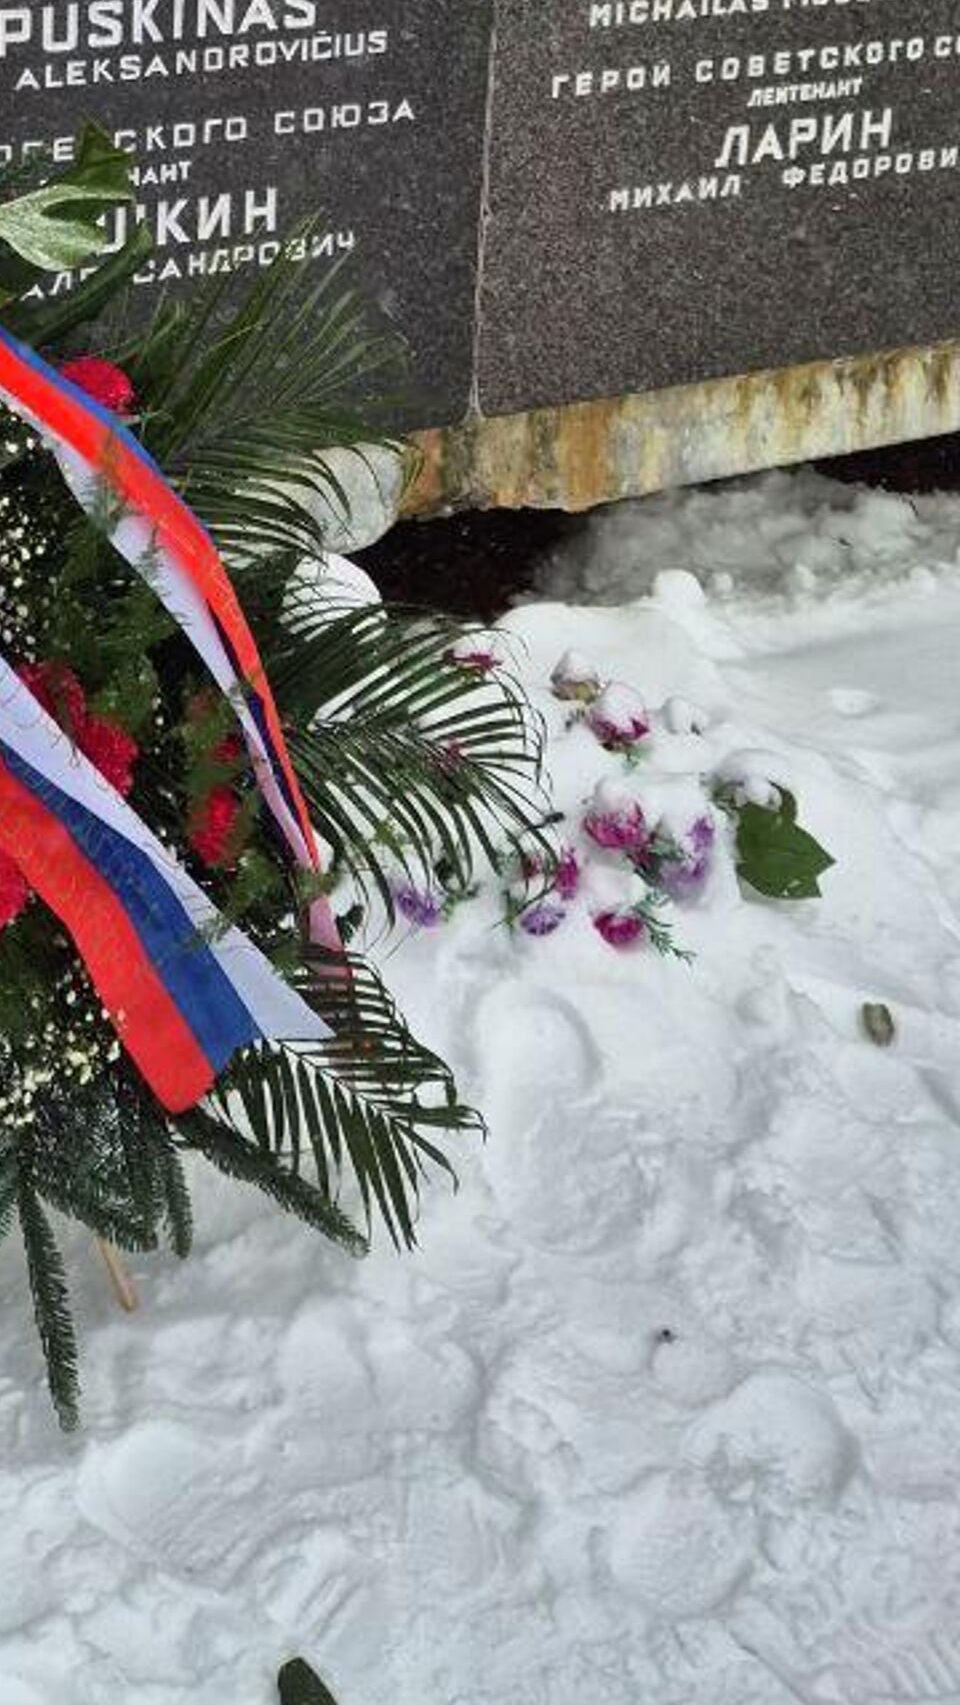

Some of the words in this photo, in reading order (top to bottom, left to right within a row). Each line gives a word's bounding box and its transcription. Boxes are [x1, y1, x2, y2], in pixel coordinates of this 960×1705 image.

[14, 29, 389, 91] ALEKSANDROVIČIUS
[551, 60, 671, 99] ГЕРОЙ
[695, 37, 925, 84] СОВЕТСКОГО
[274, 98, 417, 135] СОЮЗА
[746, 76, 863, 109] ЛЕЙТЕНАНТ
[714, 107, 893, 169] ЛАРИН
[609, 173, 742, 213] МИХАИЛ
